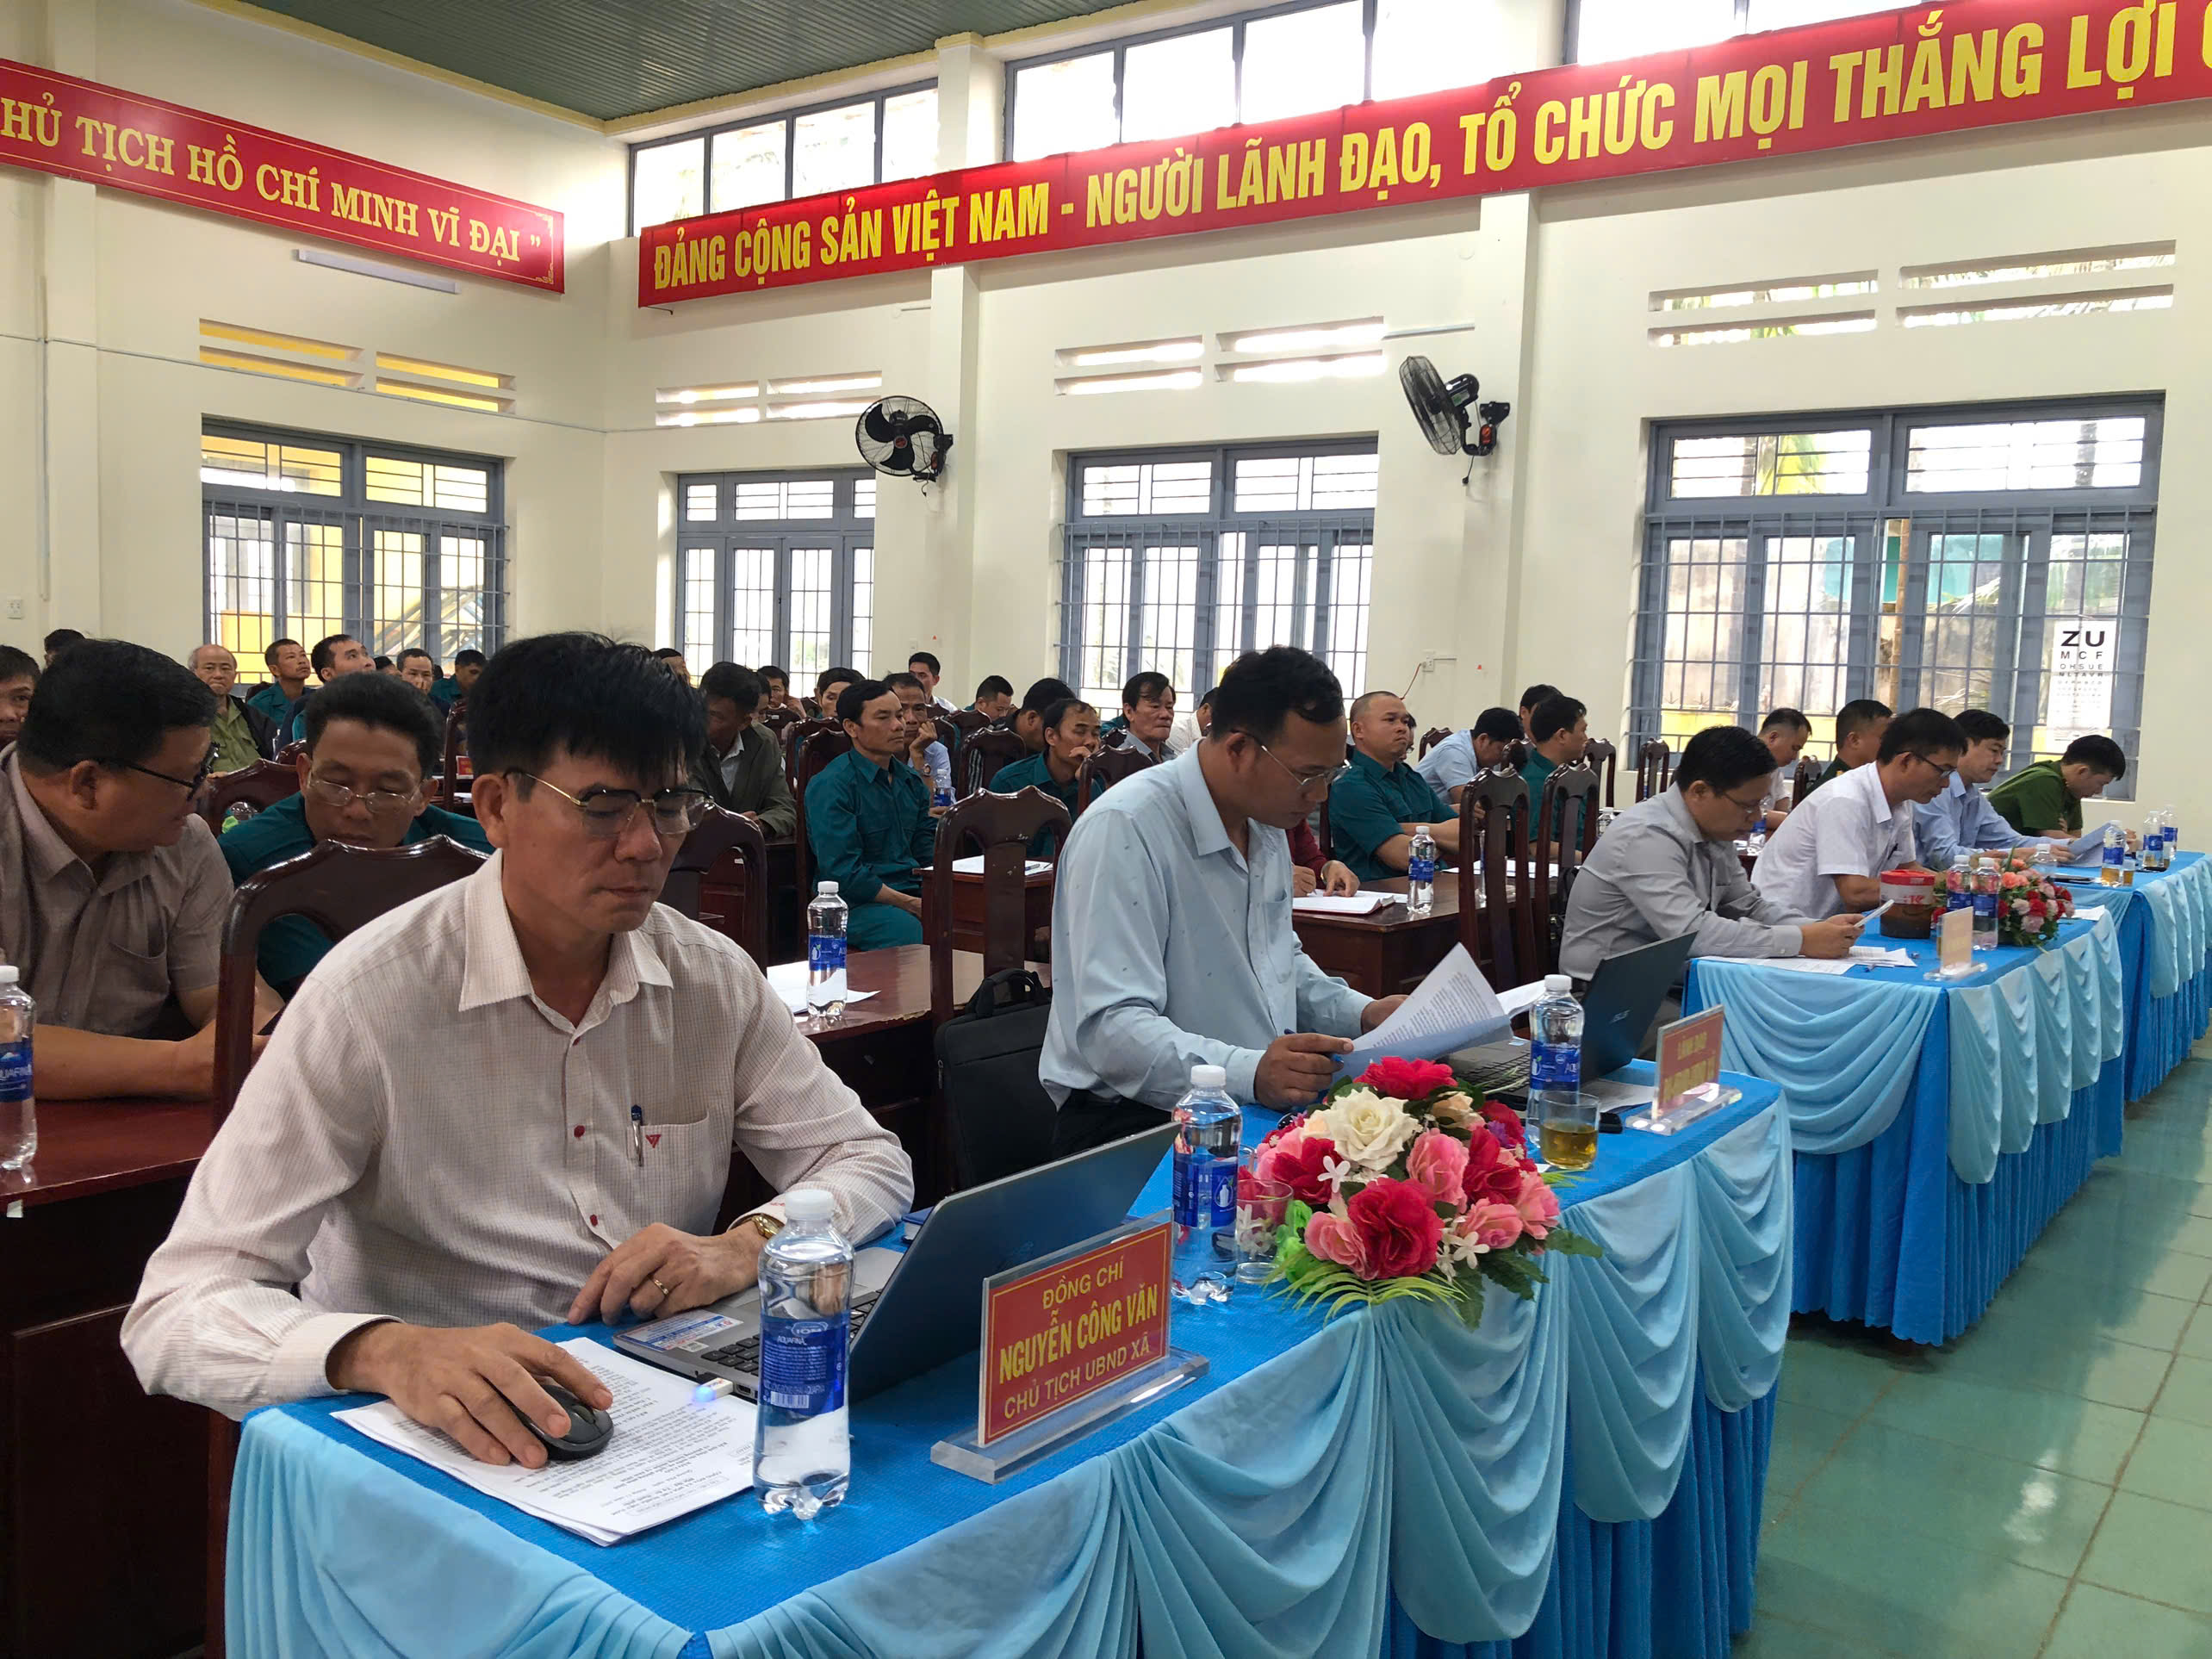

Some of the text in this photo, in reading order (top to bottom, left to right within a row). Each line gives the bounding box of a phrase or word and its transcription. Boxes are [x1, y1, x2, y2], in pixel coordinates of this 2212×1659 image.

[75, 117, 176, 177] TỊCH
[187, 134, 244, 192] HỒ
[256, 165, 321, 213] CHÍ
[331, 182, 419, 238] MINH
[426, 206, 461, 248] VĨ
[469, 218, 520, 267] ĐẠI
[655, 226, 726, 290] ĐẢNG
[734, 218, 811, 285] CỘNG
[820, 196, 882, 265] SẢN
[892, 190, 960, 262] VIỆT
[968, 182, 1050, 245] NAM
[1086, 147, 1205, 228] NGƯỜI
[1216, 136, 1327, 211] LÃNH
[1339, 121, 1442, 202] ĐẠO,
[1459, 81, 1522, 176] TỔ
[1533, 74, 1676, 165] CHỨC
[1693, 59, 1809, 151] MỌI
[1829, 9, 2045, 124] THẮNG
[2067, 0, 2178, 101] LỢI
[999, 1282, 1158, 1385] NGUYỄN CÔNG VĂN
[1042, 1255, 1124, 1310] ĐỒNG CHÍ
[1003, 1331, 1150, 1420] CHỦ TỊCH UBND XÃ
